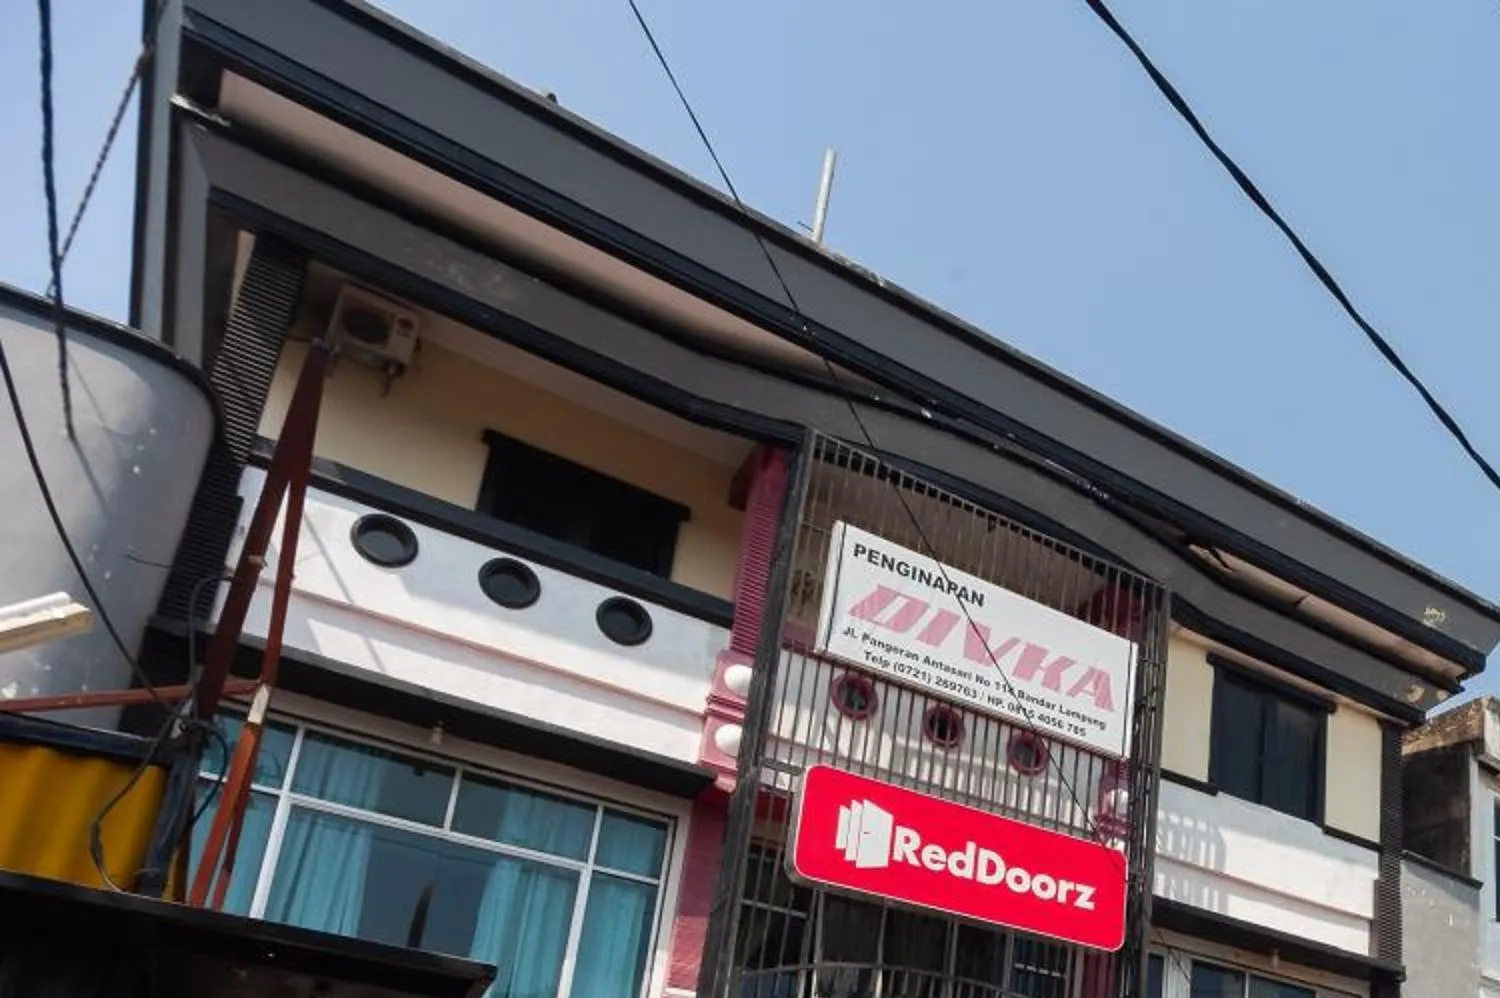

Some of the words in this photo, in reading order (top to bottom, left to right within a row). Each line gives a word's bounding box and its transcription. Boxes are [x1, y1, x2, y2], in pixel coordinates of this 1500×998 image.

[853, 543, 985, 608] PENGINAPAN
[847, 583, 1116, 713] DIVKA
[861, 632, 919, 662] Pangeran
[923, 655, 973, 681] Antasari
[1017, 689, 1057, 711] Bandar
[1059, 703, 1107, 731] Lampung
[864, 649, 891, 668] Telp
[893, 825, 1096, 911] RedDoorz
